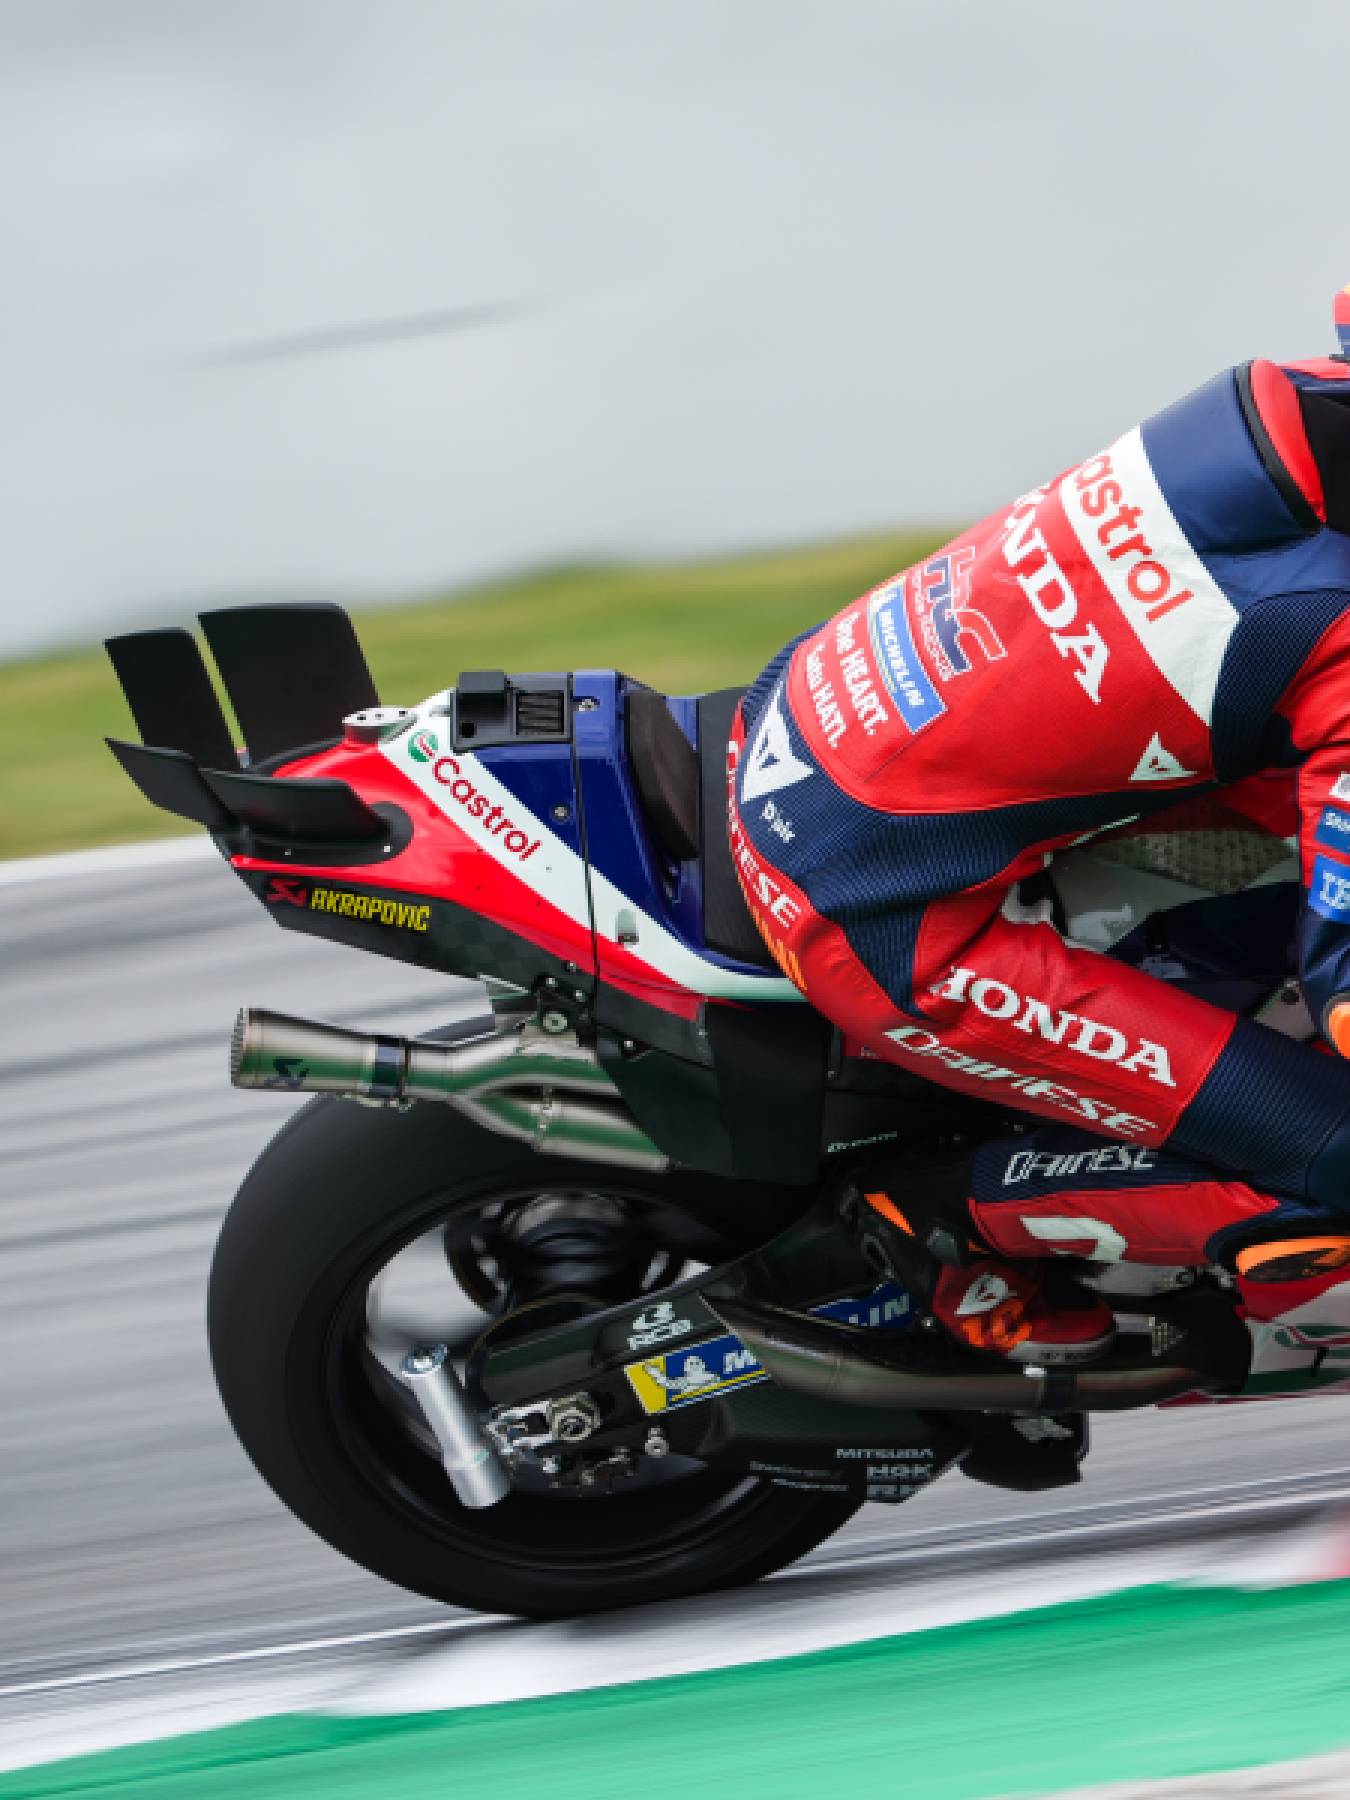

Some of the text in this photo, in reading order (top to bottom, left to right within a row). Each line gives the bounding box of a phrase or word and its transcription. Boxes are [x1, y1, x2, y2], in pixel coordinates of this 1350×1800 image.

[1074, 455, 1195, 622] astrol
[1000, 486, 1109, 704] NDA
[878, 608, 925, 706] MICHELIN
[431, 753, 545, 863] Castrol
[835, 1447, 935, 1460] MITSUBA
